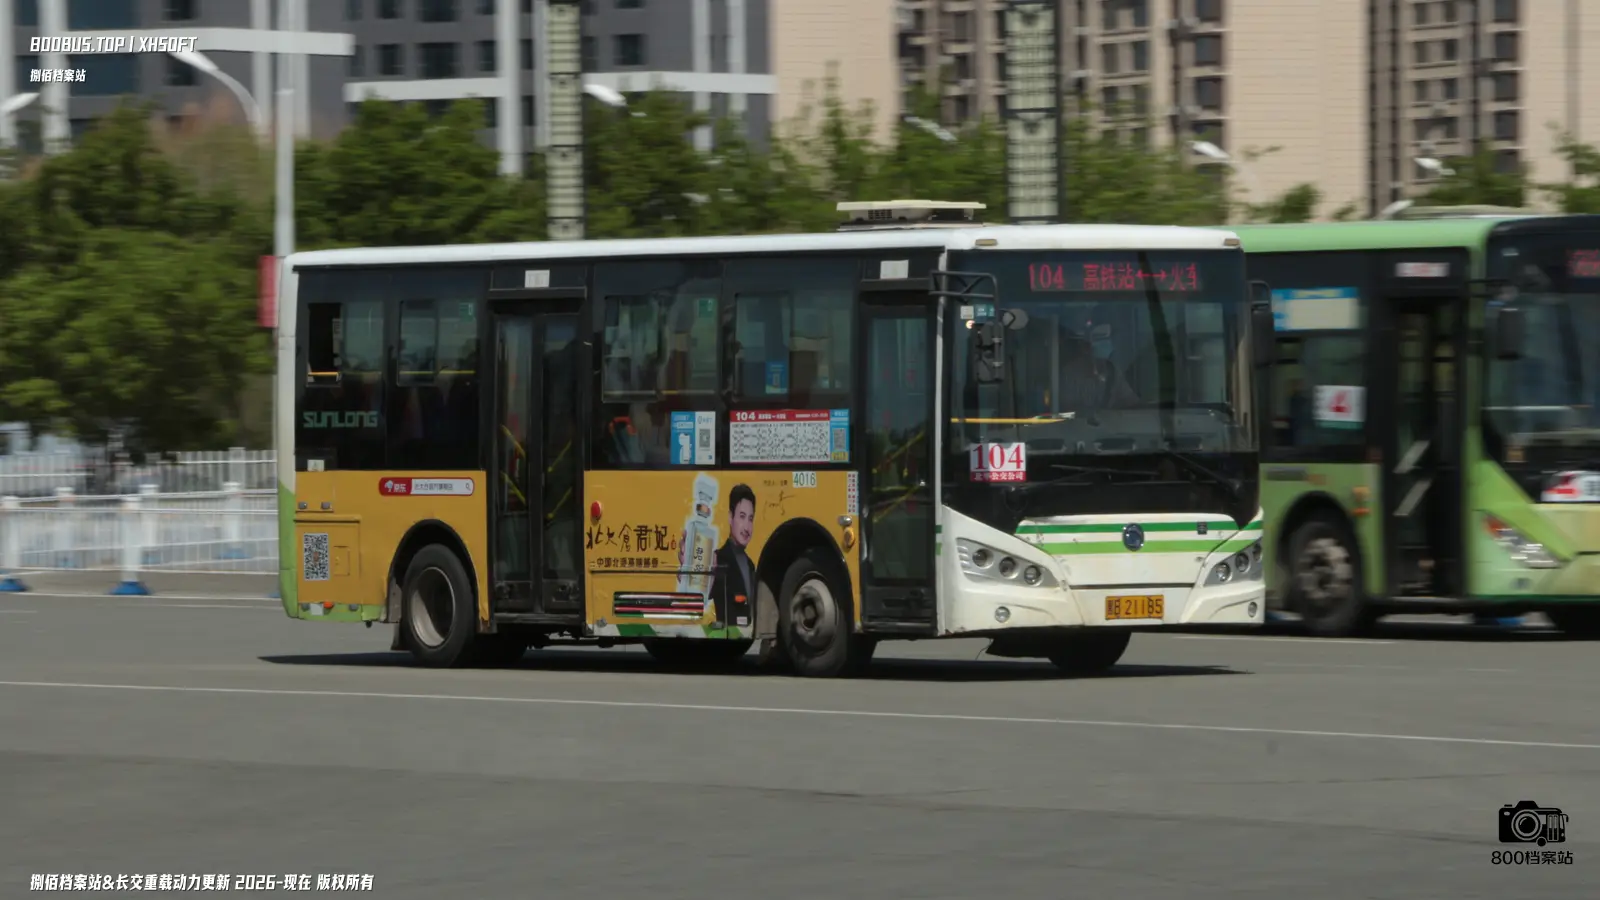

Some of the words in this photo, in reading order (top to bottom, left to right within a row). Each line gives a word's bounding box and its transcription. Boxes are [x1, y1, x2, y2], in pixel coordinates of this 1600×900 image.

[1029, 263, 1065, 291] 104
[1083, 263, 1136, 291] 高铁站
[303, 411, 378, 428] SUNLONG
[736, 412, 756, 421] 104
[972, 444, 1025, 470] 104
[793, 472, 816, 487] 4016
